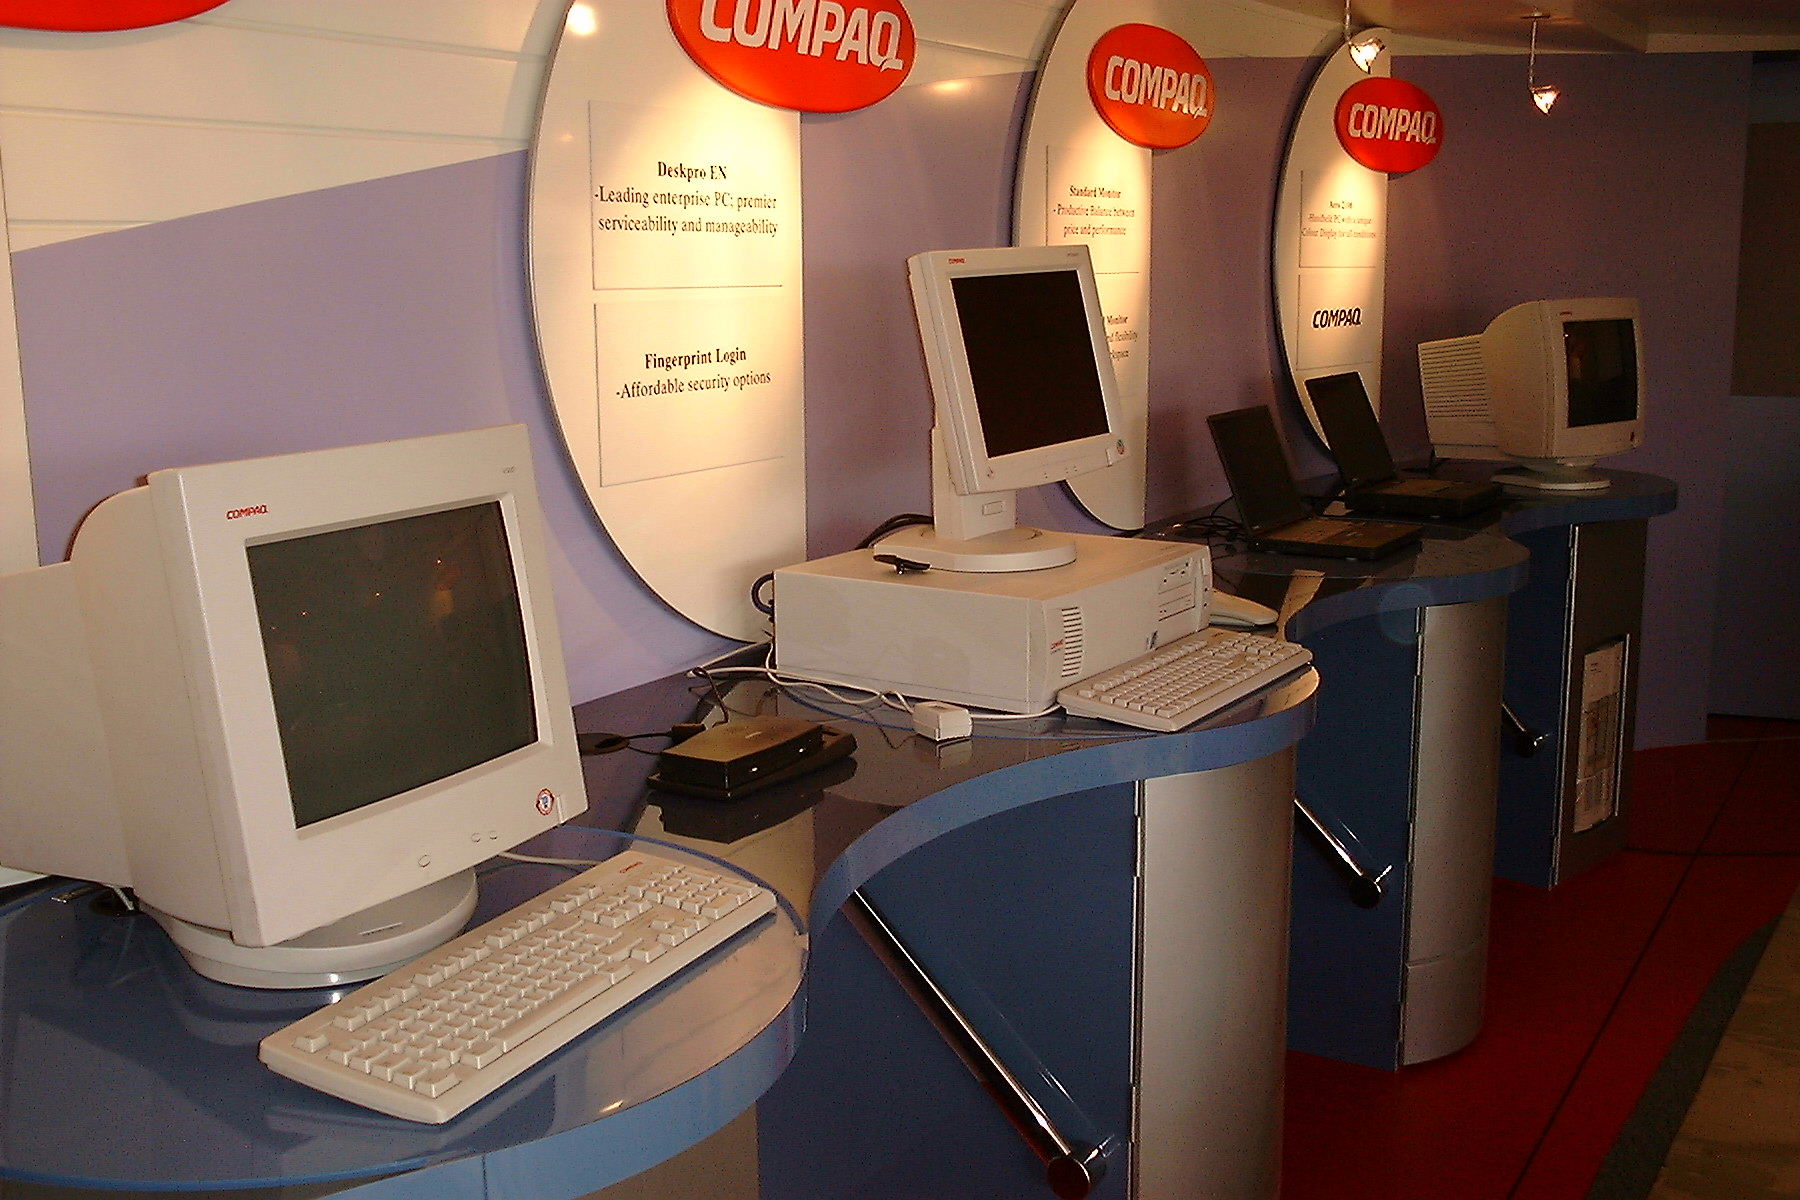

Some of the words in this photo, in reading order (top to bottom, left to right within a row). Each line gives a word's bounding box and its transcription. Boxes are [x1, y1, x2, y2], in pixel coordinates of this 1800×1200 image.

[700, 0, 904, 72] COMPAQ
[1105, 55, 1208, 118] COMPAQ
[1349, 102, 1437, 145] COMPAQ
[657, 161, 706, 182] Deskpro
[711, 165, 727, 180] EN
[653, 190, 711, 210] enterprise
[737, 193, 777, 212] premier
[1069, 185, 1097, 198] Standard
[598, 214, 678, 236] serviceability
[682, 218, 702, 232] and
[705, 218, 778, 237] manageability
[1312, 307, 1362, 329] COMPAQ
[645, 350, 712, 371] Fingerprint
[716, 347, 747, 367] Login
[688, 373, 730, 392] security
[733, 370, 771, 388] options
[225, 504, 268, 520] COMPAQ
